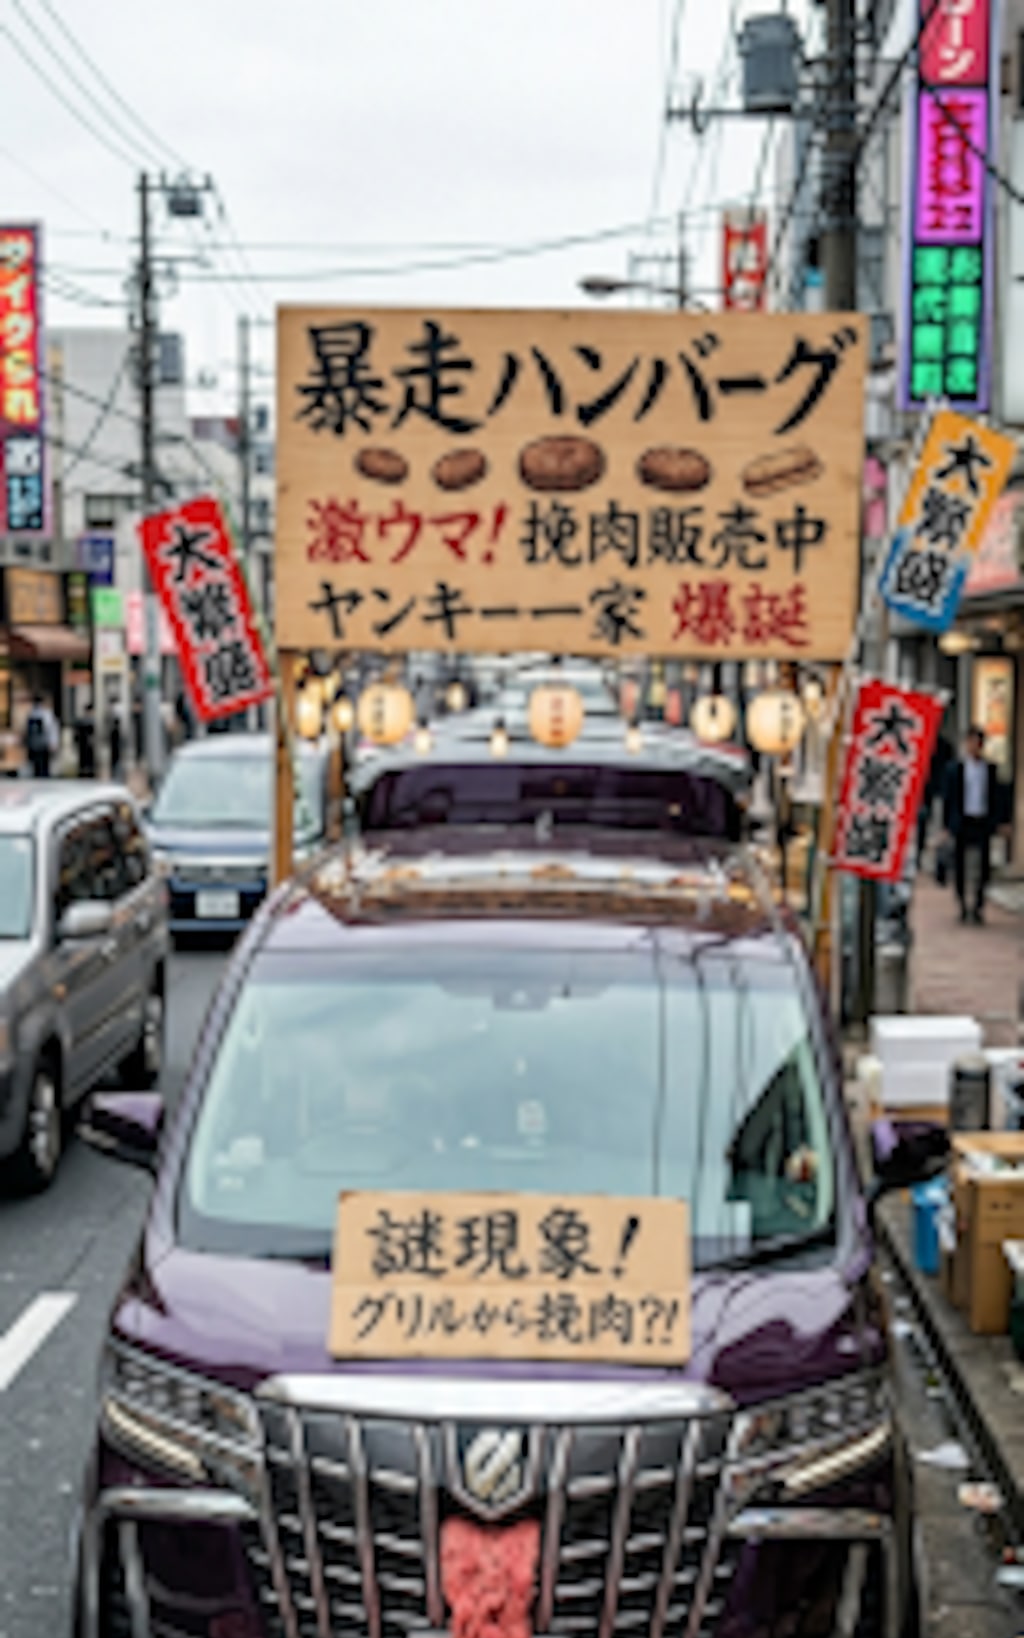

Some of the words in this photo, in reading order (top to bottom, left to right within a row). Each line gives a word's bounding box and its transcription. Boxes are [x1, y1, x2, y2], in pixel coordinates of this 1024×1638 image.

[295, 320, 858, 435] 暴走ハンバーグ
[306, 501, 508, 566] 激ウマ!
[519, 501, 827, 573] 挽肉販売中
[308, 581, 647, 646] ヤンキー一家
[671, 581, 811, 648] 爆誕
[365, 1208, 640, 1279] 謎現象!
